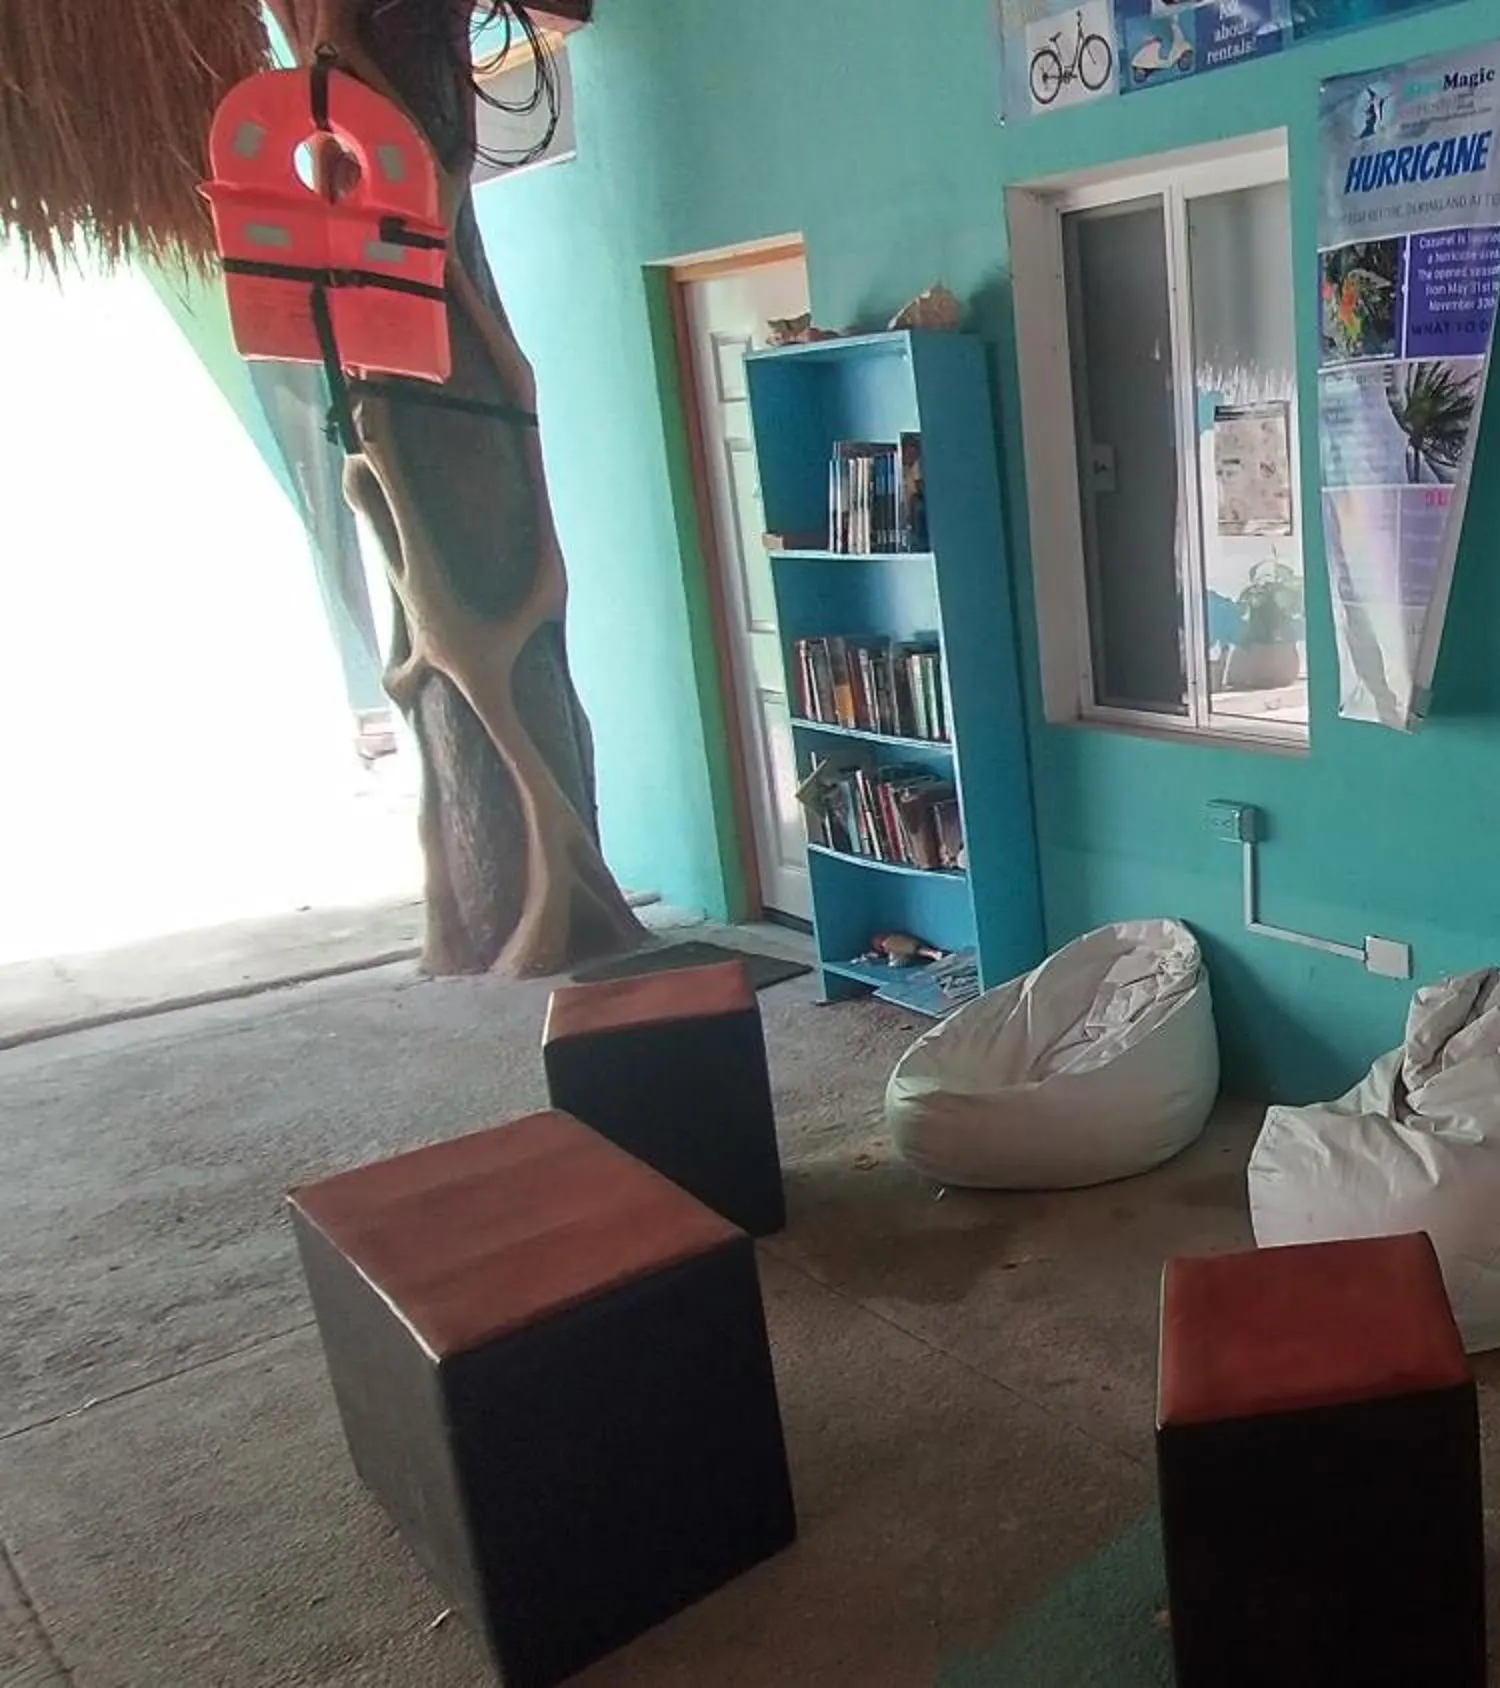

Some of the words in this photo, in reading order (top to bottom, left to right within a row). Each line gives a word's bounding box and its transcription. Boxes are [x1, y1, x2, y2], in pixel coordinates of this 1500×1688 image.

[1344, 130, 1492, 195] HURRICANE
[1447, 194, 1467, 209] AND
[1417, 268, 1432, 280] The
[1425, 283, 1446, 296] from
[1448, 281, 1467, 295] May
[1429, 298, 1475, 311] November
[1411, 321, 1450, 335] WHAT
